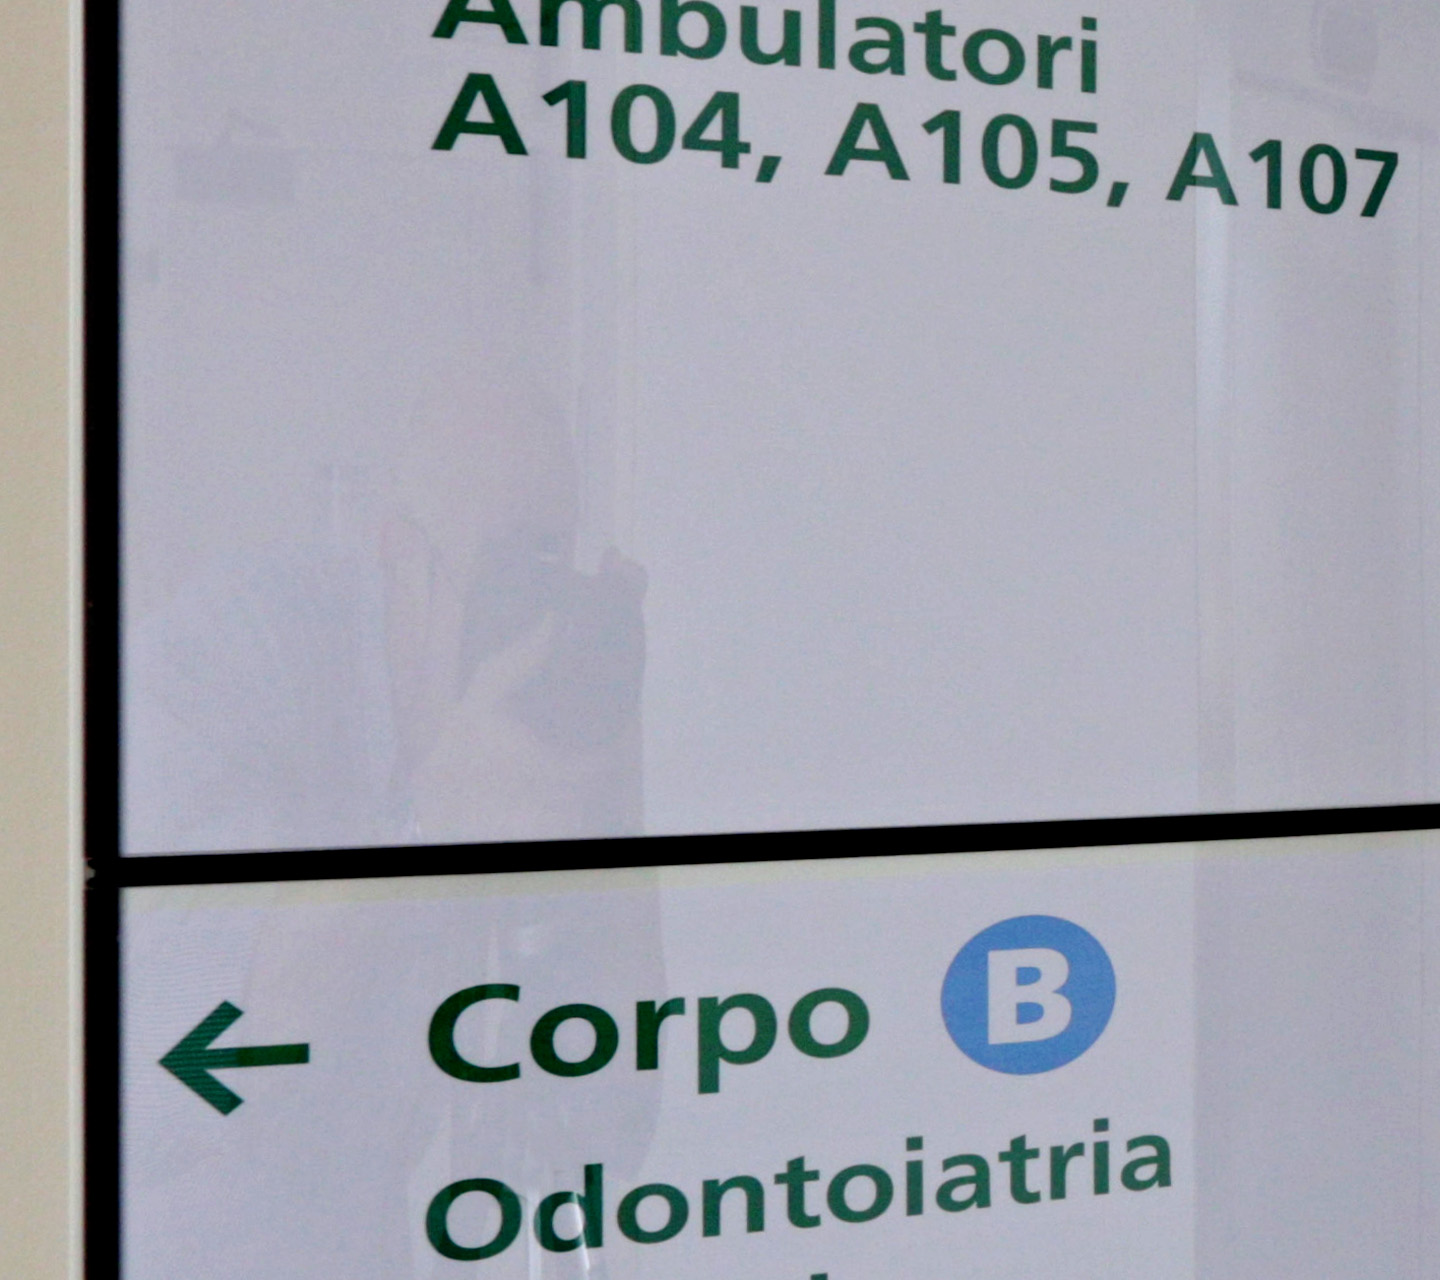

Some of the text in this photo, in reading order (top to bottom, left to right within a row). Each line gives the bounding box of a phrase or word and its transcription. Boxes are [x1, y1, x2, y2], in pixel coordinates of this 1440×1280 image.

[432, 71, 1400, 219] A104, A105, A107
[426, 946, 1074, 1095] Corpo B
[425, 1116, 1174, 1263] Odontoiatria
